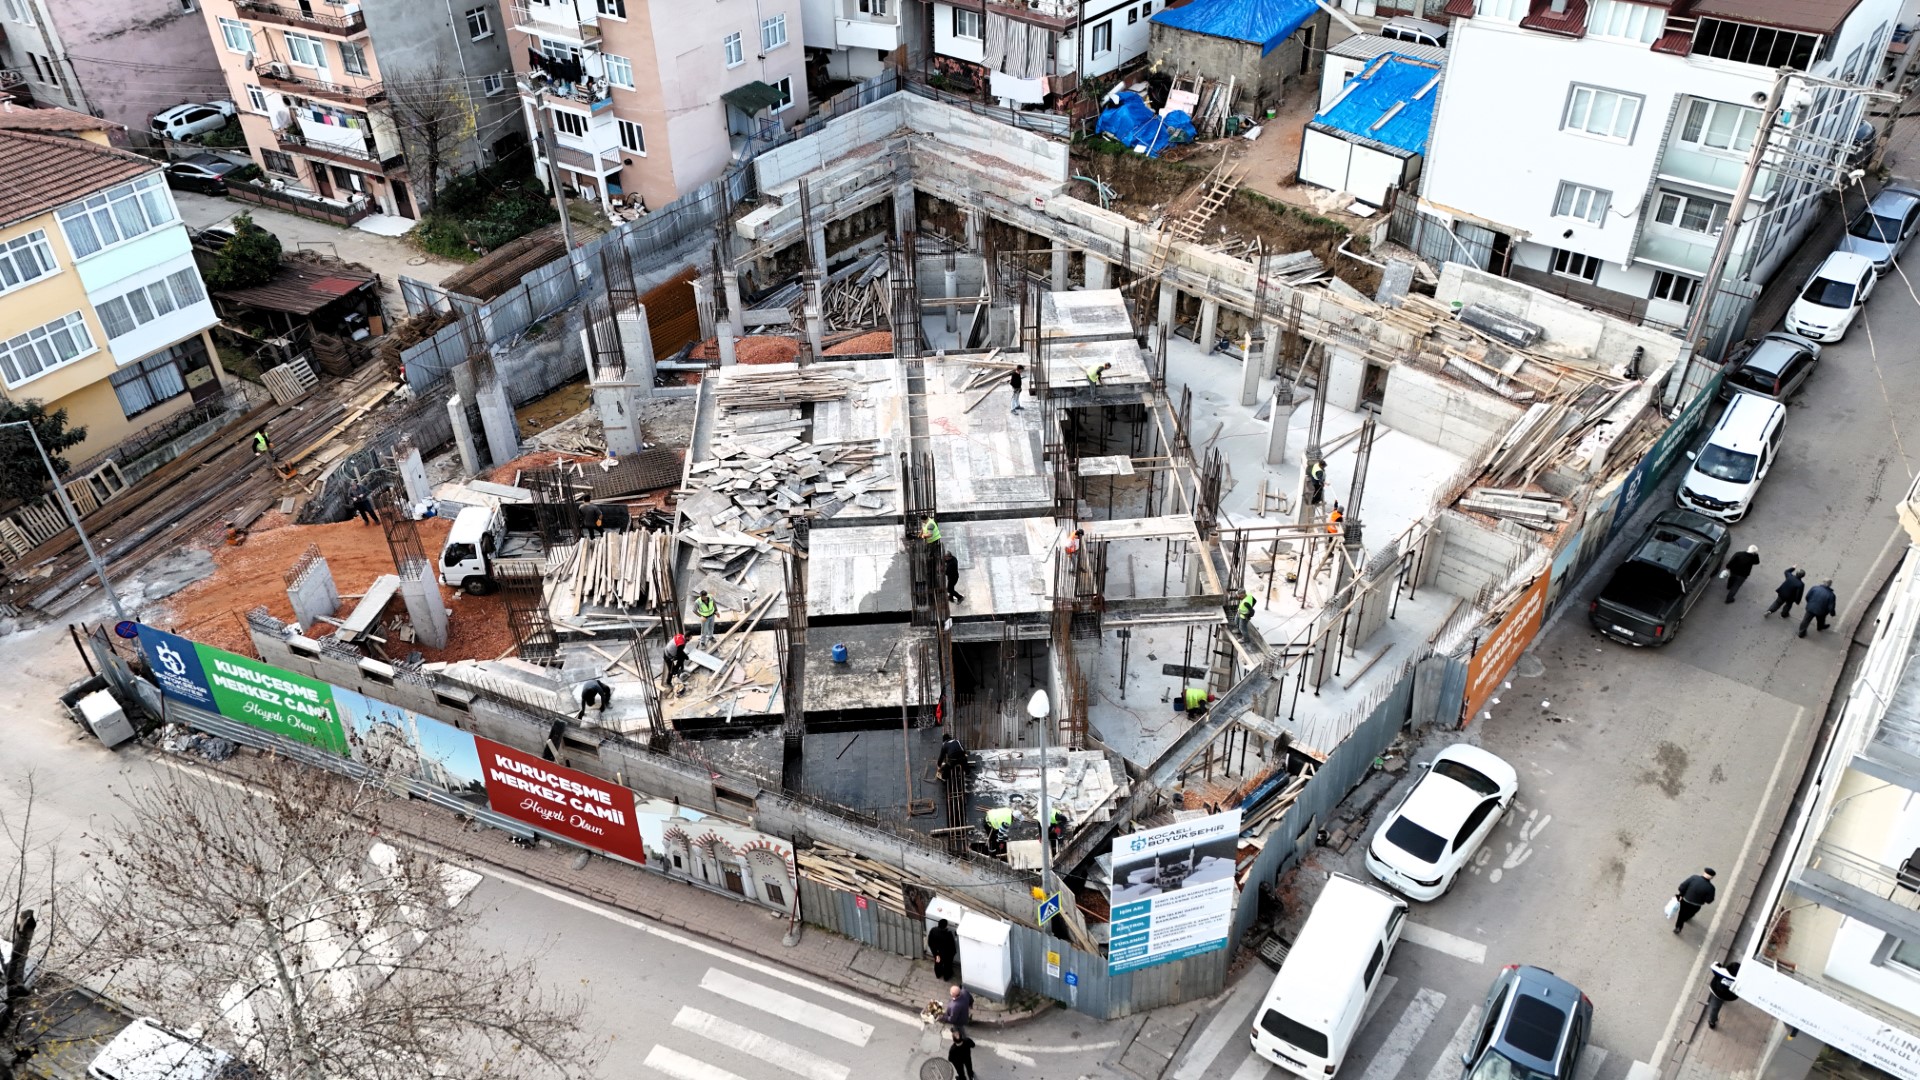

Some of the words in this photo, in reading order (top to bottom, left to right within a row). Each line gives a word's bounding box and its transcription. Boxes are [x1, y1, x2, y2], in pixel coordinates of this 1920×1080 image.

[212, 673, 283, 706] MERKEZ
[213, 659, 320, 703] KURUÇEŞME
[242, 700, 284, 722] Hayırlı
[287, 714, 318, 734] Olsun
[489, 767, 567, 806] MERKEZ
[569, 797, 626, 826] CAMİİ
[494, 753, 612, 806] KURUÇEŞME
[519, 797, 567, 822] Hayırlı
[569, 814, 605, 836] Olsun
[1148, 827, 1192, 841] KOCAELİ
[1148, 824, 1225, 848] BÜYÜKŞEHİR
